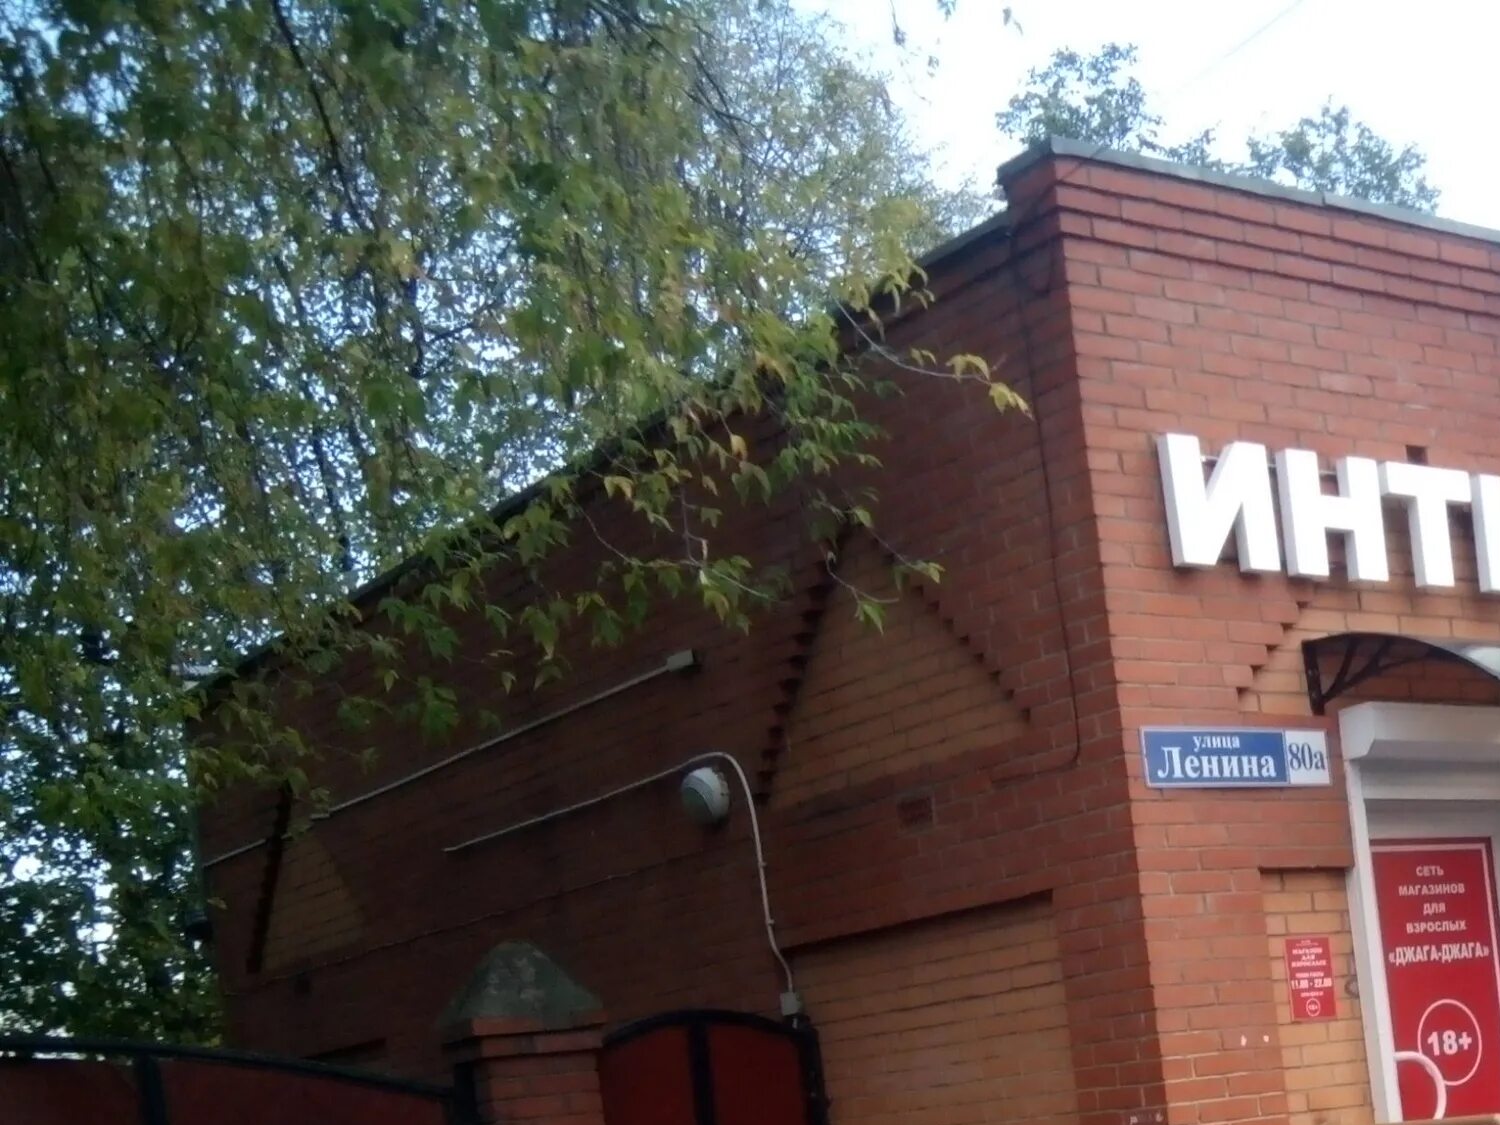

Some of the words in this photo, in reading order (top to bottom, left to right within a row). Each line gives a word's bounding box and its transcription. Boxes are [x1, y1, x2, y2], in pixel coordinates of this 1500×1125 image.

[1192, 735, 1241, 752] улица
[1157, 745, 1277, 779] Ленина
[1287, 742, 1326, 772] 80а
[1415, 865, 1445, 877] СЕТЬ
[1398, 883, 1465, 897] МАГАЗИНОВ
[1423, 902, 1446, 916] ДЛЯ
[1406, 920, 1467, 934] ВЗРОСЛЫХ
[1388, 942, 1490, 967] «ДЖАГА-ДЖАГА»
[1426, 1028, 1473, 1057] 18+
